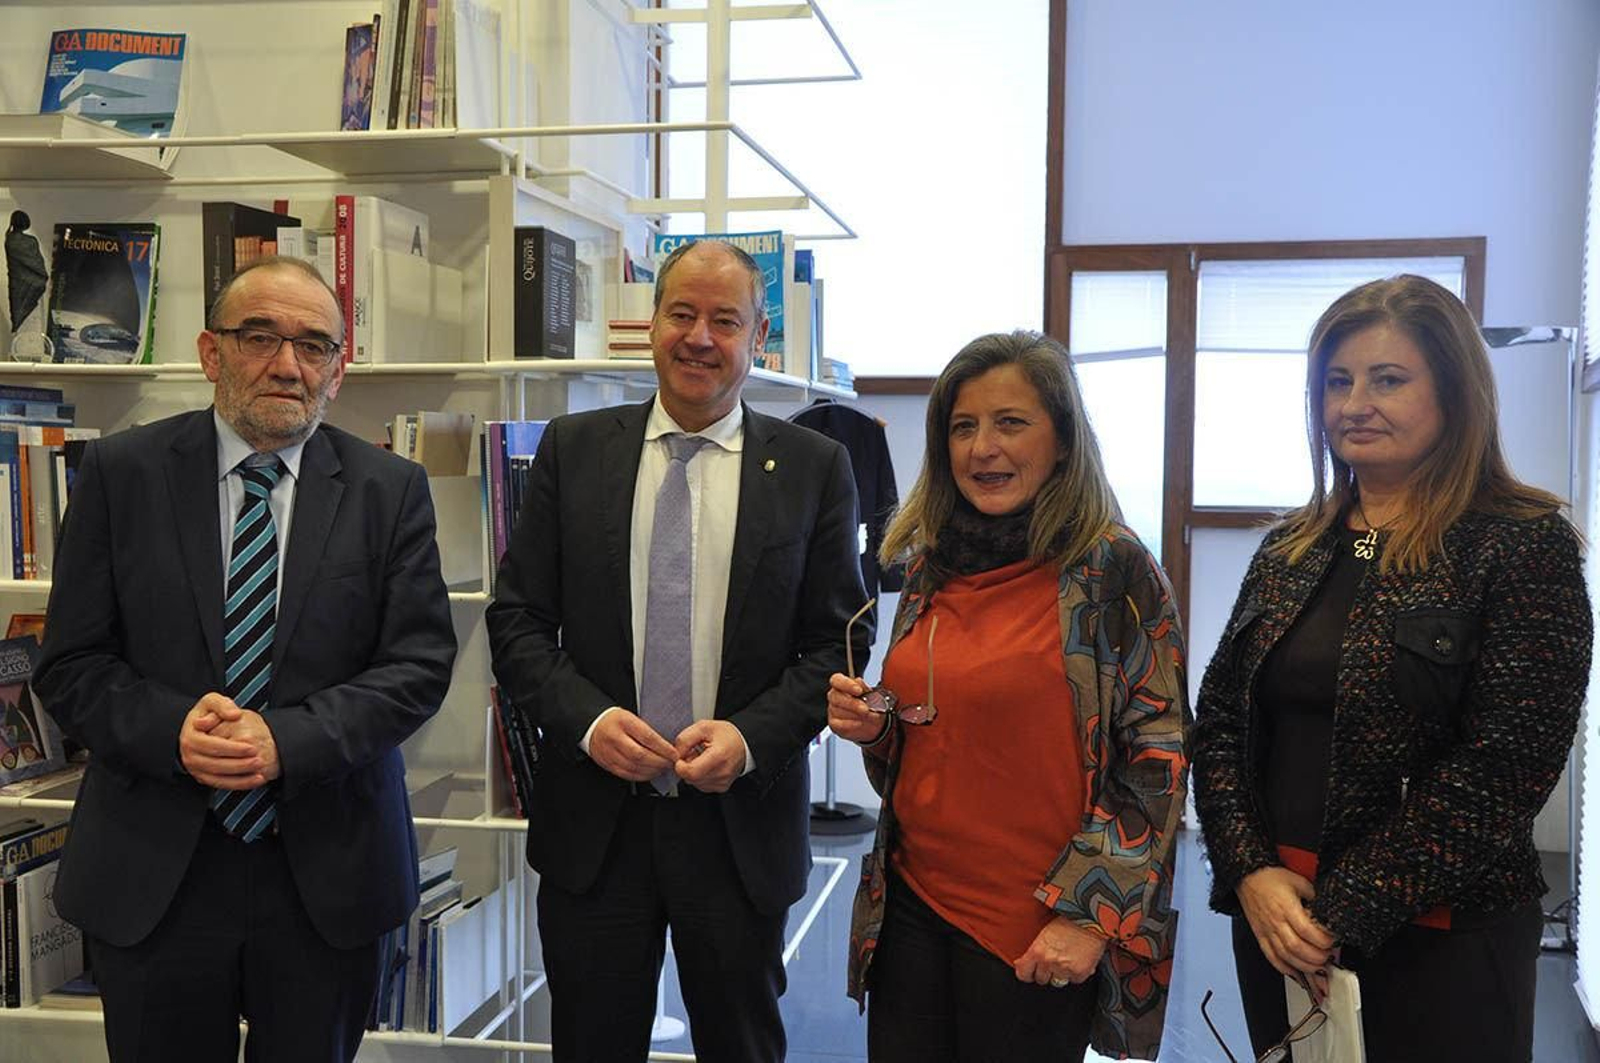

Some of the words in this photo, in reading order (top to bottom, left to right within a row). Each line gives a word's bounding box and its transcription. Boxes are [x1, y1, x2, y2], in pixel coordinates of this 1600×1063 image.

[53, 33, 82, 53] GA
[85, 32, 182, 56] DOCUMENT
[63, 238, 119, 253] TECTONICA
[126, 240, 149, 262] 17
[410, 225, 423, 257] A
[339, 273, 346, 285] DE
[6, 842, 31, 865] GA
[32, 827, 68, 858] DOCU
